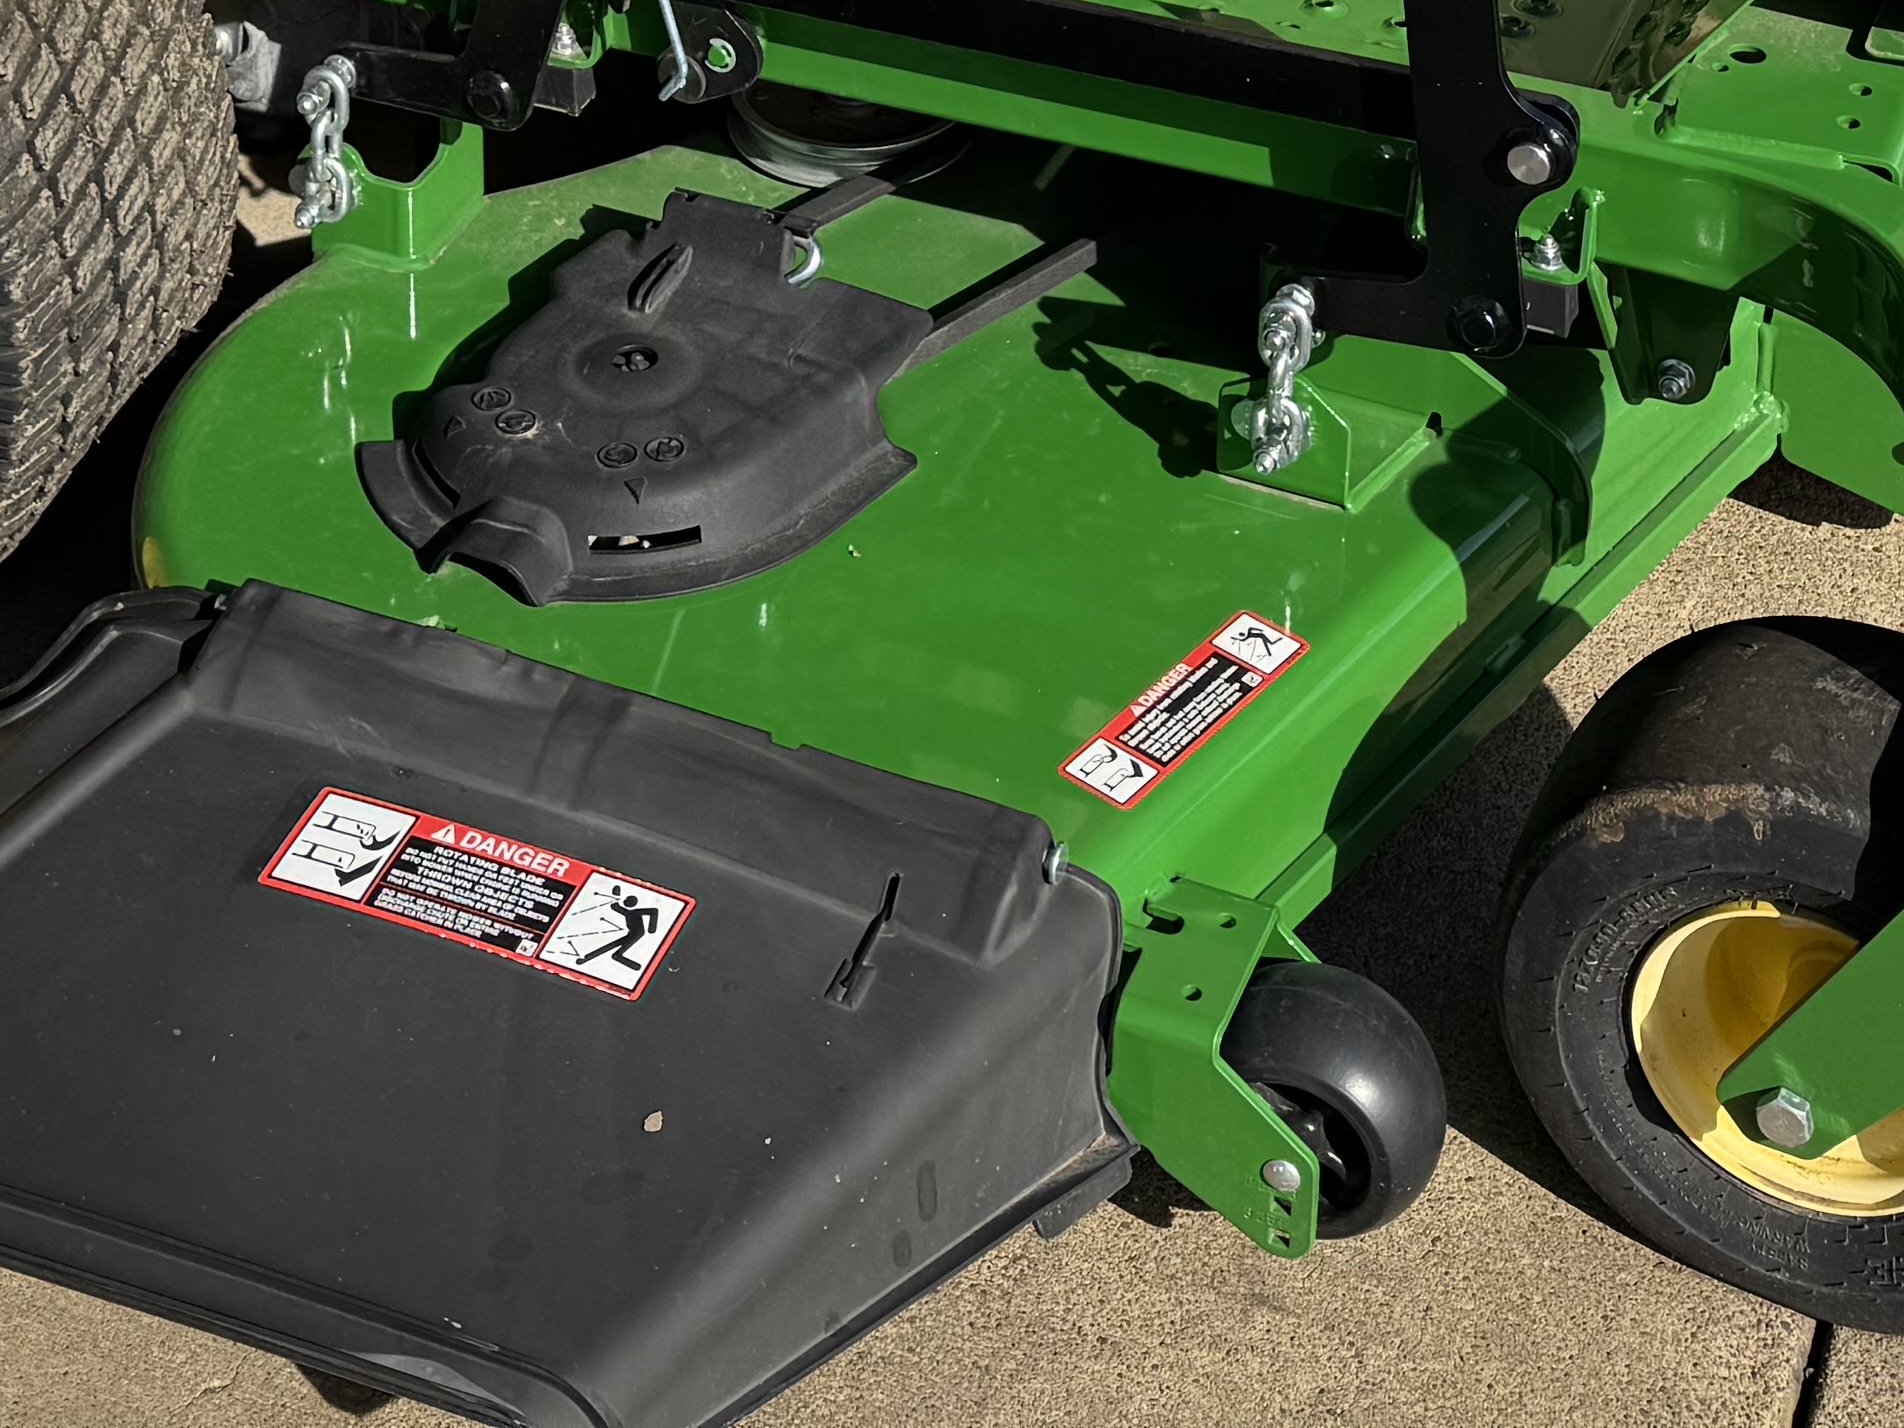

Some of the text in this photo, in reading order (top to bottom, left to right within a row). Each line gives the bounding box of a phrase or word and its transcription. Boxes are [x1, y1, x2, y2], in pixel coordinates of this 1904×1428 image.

[1136, 661, 1194, 709] DANGER
[432, 844, 547, 887] ROTATING BLADE
[458, 828, 572, 879] DANGER
[414, 865, 536, 909] THROWN OBJECTS
[1751, 1237, 1809, 1272] SAFETY
